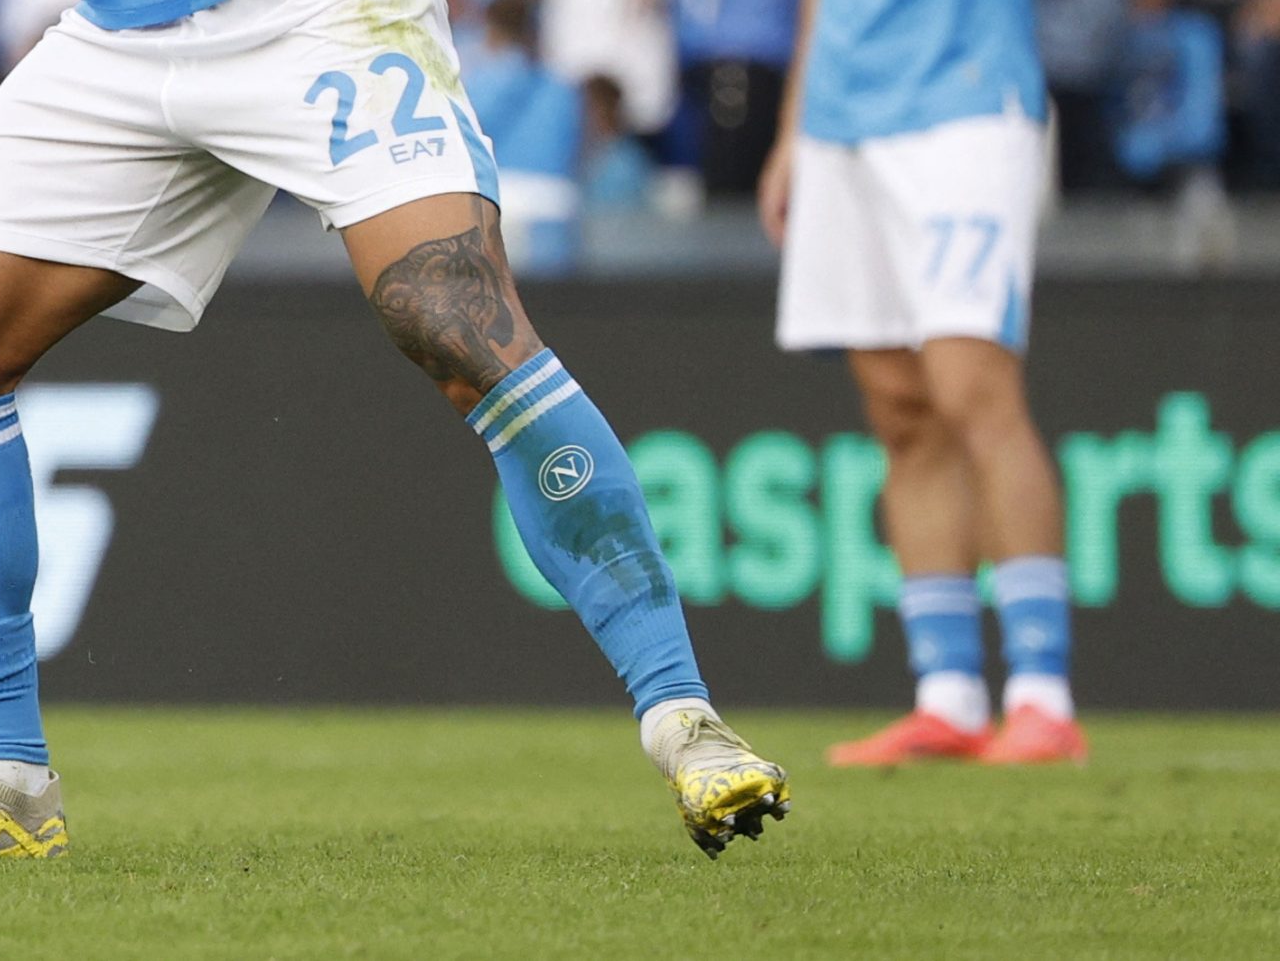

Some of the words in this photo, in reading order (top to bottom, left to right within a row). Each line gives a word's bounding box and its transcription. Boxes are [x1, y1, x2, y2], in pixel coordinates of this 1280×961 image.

[303, 51, 448, 167] 22
[388, 137, 447, 165] EA7
[923, 213, 1003, 287] 77
